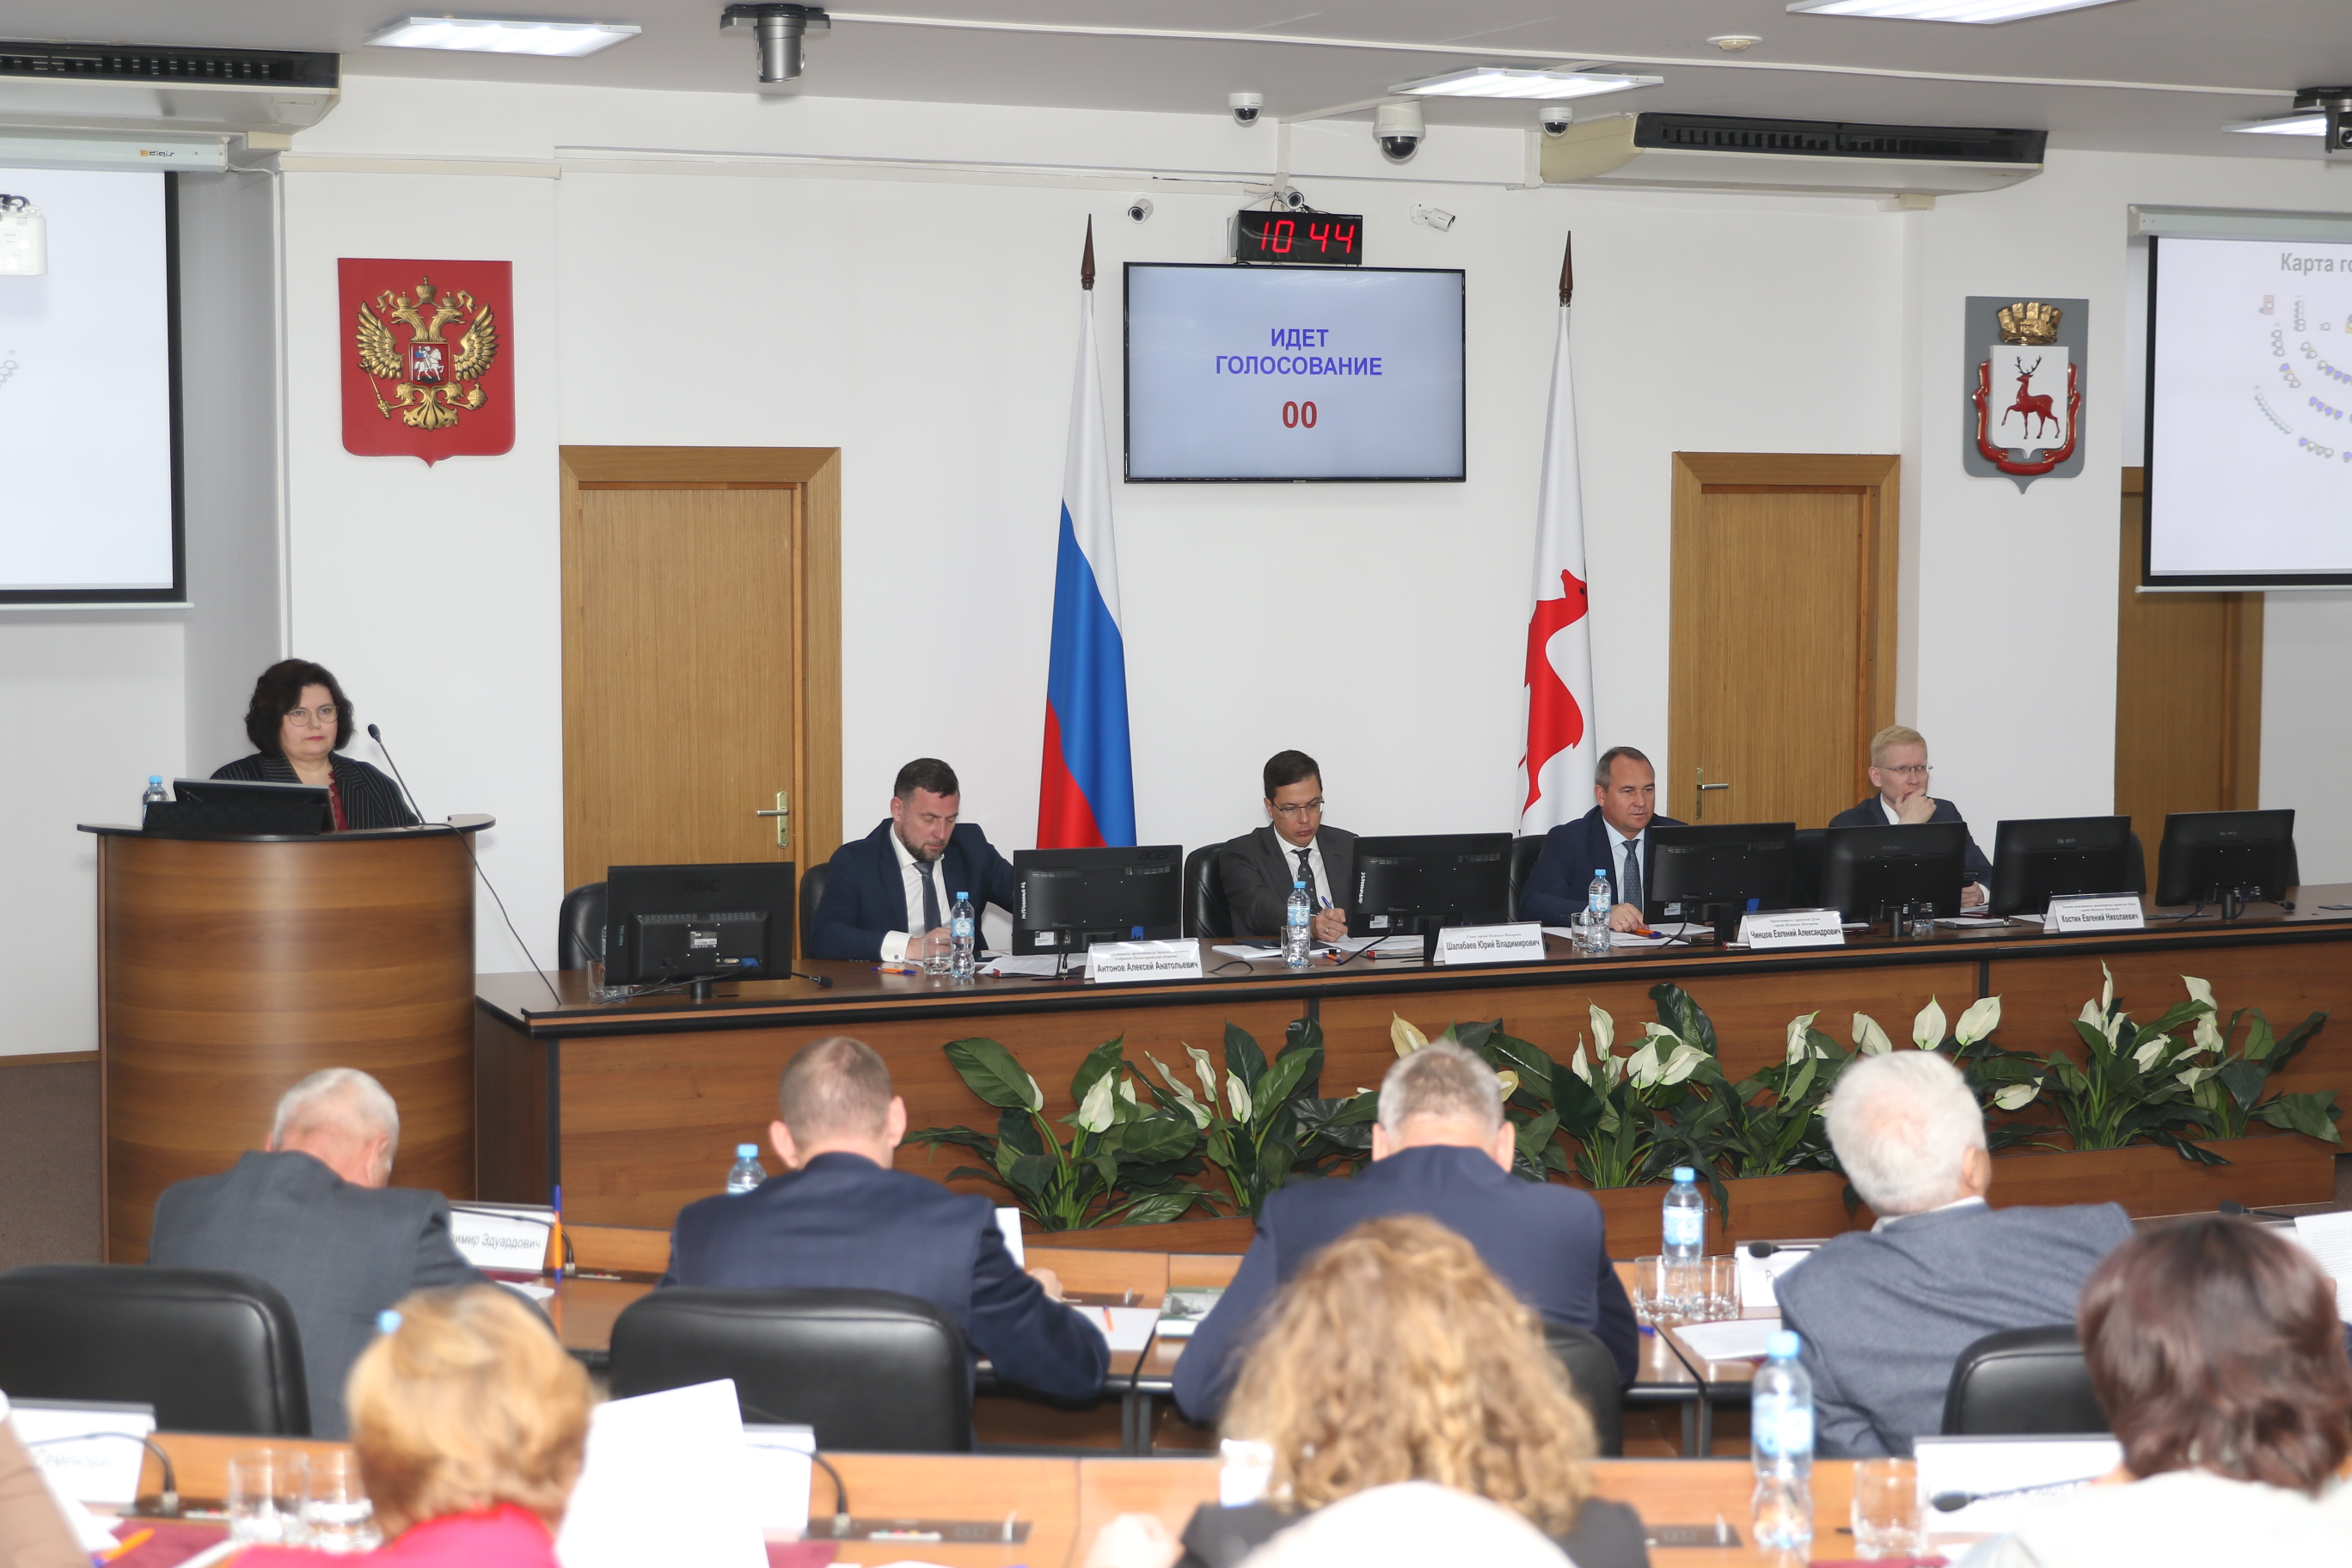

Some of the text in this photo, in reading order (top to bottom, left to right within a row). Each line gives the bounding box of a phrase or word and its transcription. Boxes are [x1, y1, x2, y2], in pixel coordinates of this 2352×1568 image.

[2281, 253, 2334, 276] Карта
[1271, 328, 1329, 351] ИДЕТ
[1216, 355, 1382, 376] ГОЛОСОВАНИЕ
[1282, 401, 1318, 429] 00
[1138, 849, 1174, 860] acer
[2061, 913, 2139, 923] Костин Евгений Николаевич
[1750, 928, 1841, 940] Чинцов Евгений Александрович
[1446, 940, 1540, 951] Шалабаев Юрий Владимирович
[1097, 961, 1197, 973] Антонов Алексей Анатольевич
[481, 1233, 542, 1251] Эдуардович
